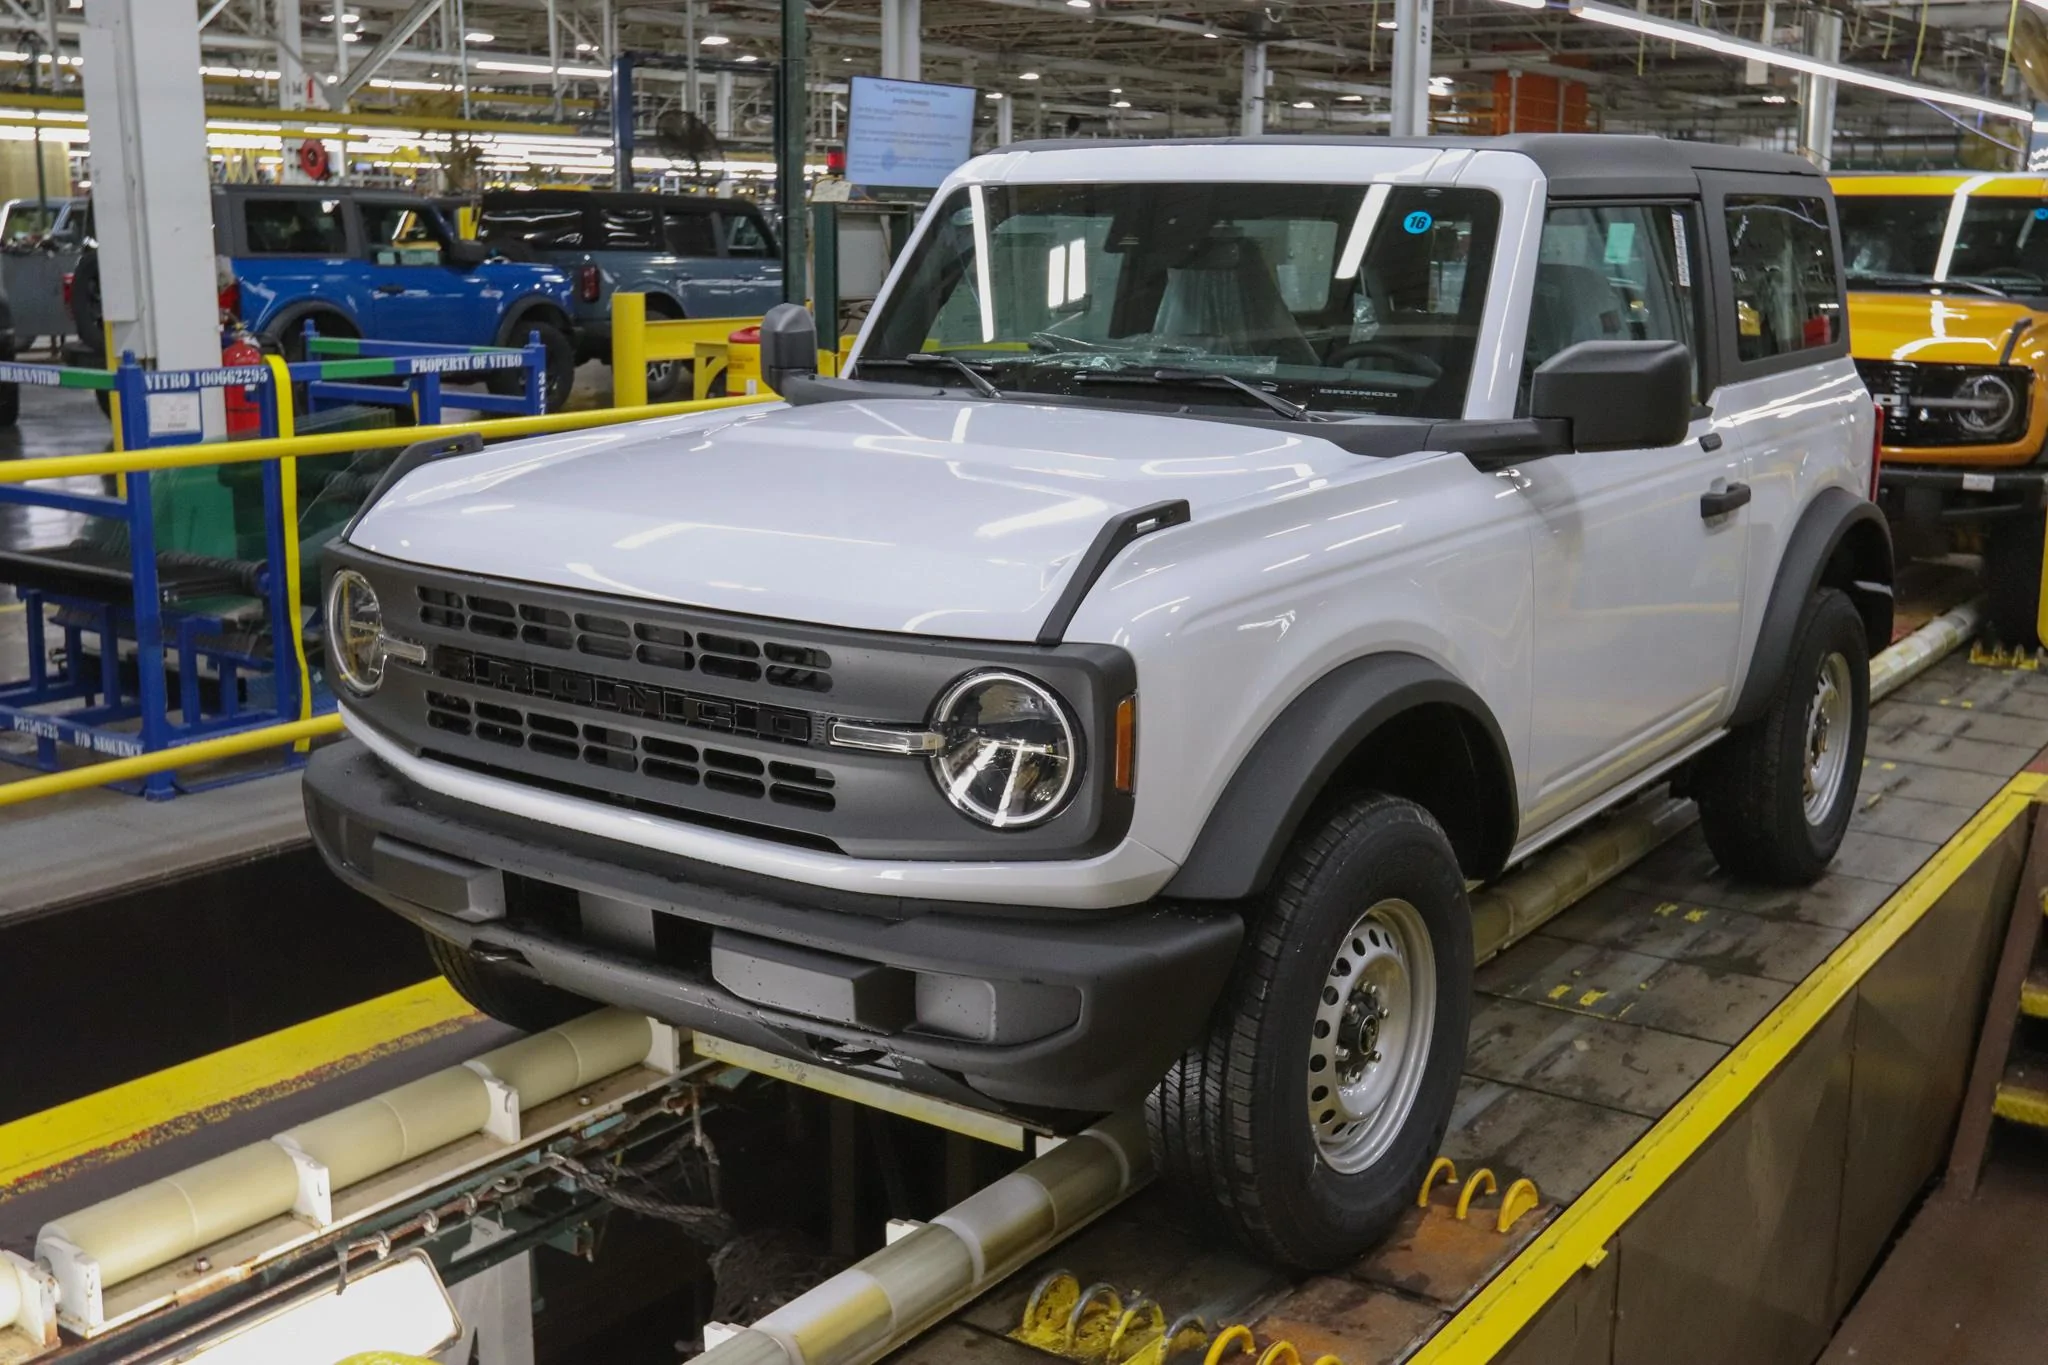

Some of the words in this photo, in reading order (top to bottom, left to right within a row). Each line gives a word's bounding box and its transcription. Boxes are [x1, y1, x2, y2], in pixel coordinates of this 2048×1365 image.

[1410, 215, 1427, 230] 16
[411, 357, 471, 374] PROPERTY
[472, 355, 488, 370] OF
[488, 353, 523, 369] VITRO
[144, 373, 191, 391] VITRO
[194, 367, 269, 388] 100662295
[1319, 388, 1398, 399] BRONCO
[433, 644, 812, 742] BRONCO
[93, 735, 144, 756] SEQUENCE
